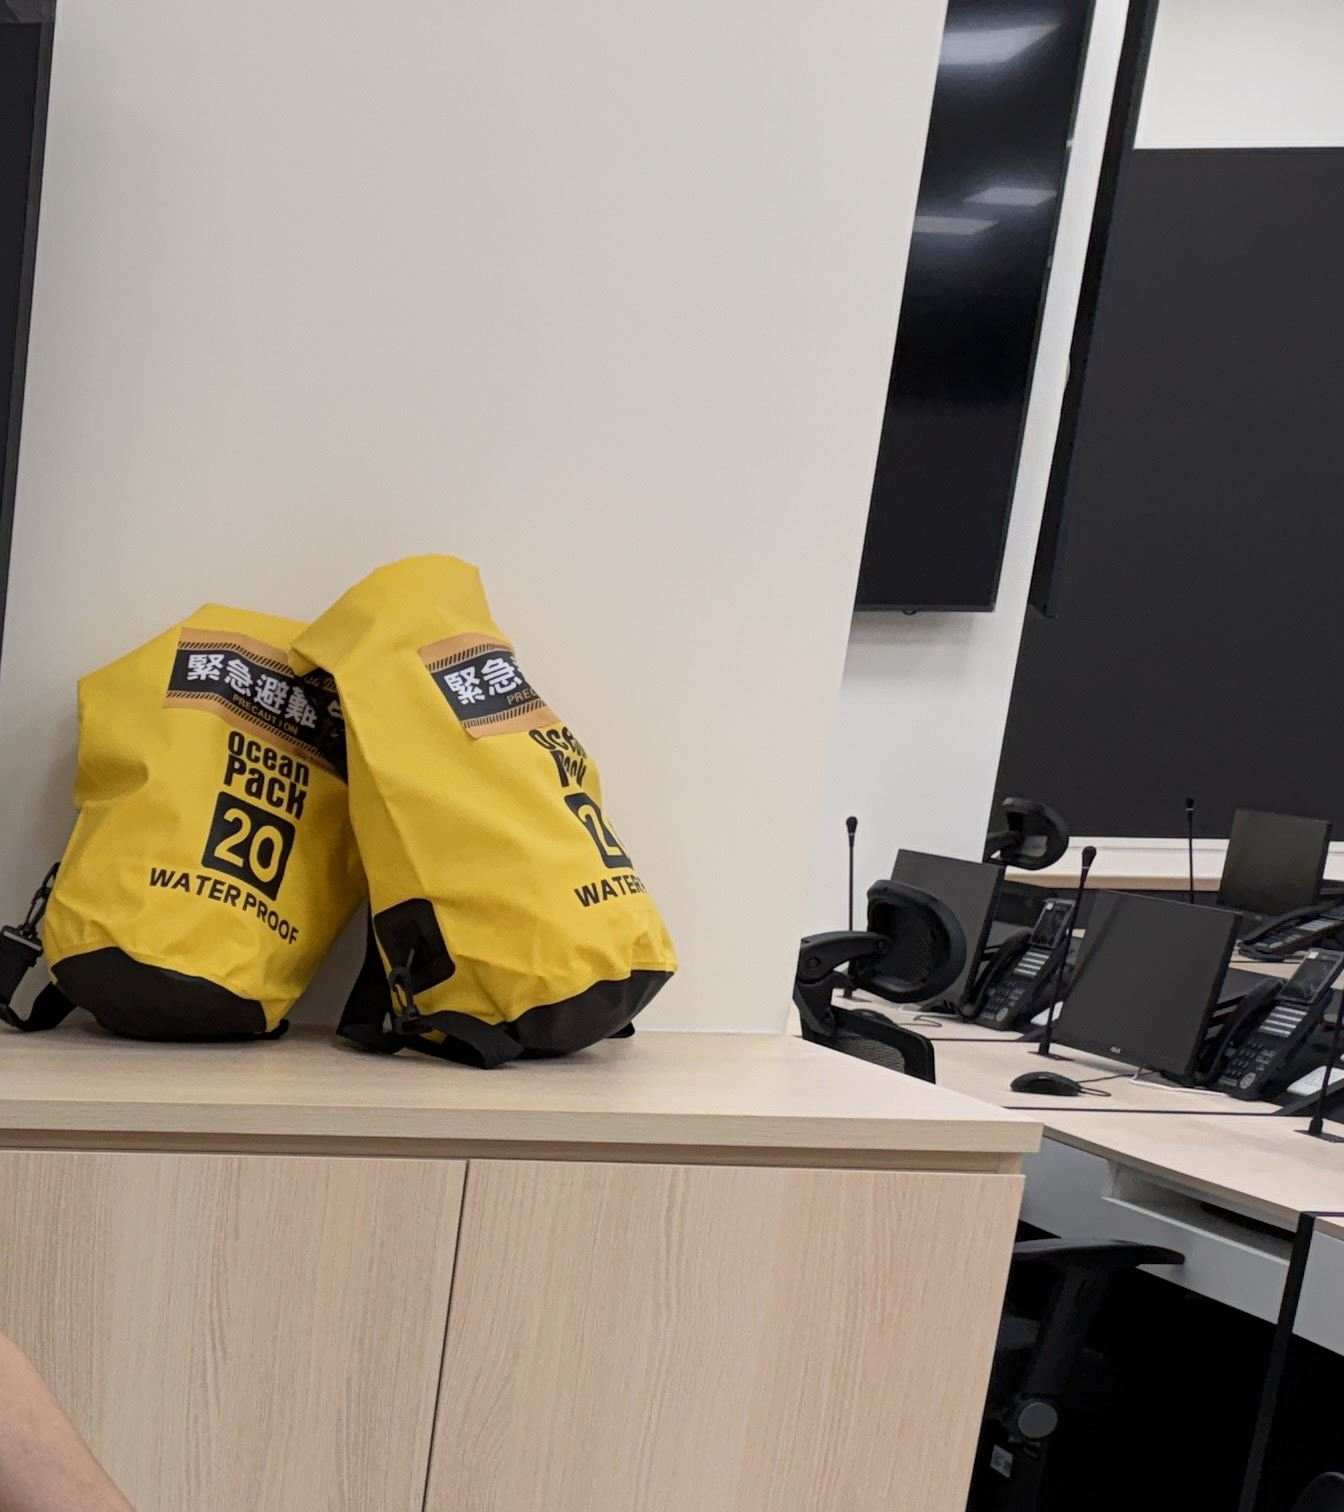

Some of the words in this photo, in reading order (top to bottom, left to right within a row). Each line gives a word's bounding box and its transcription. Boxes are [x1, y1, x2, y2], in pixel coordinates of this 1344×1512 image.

[186, 654, 343, 729] 緊急避難
[223, 754, 308, 821] Pack
[228, 730, 310, 787] Ocean
[213, 806, 285, 883] 20
